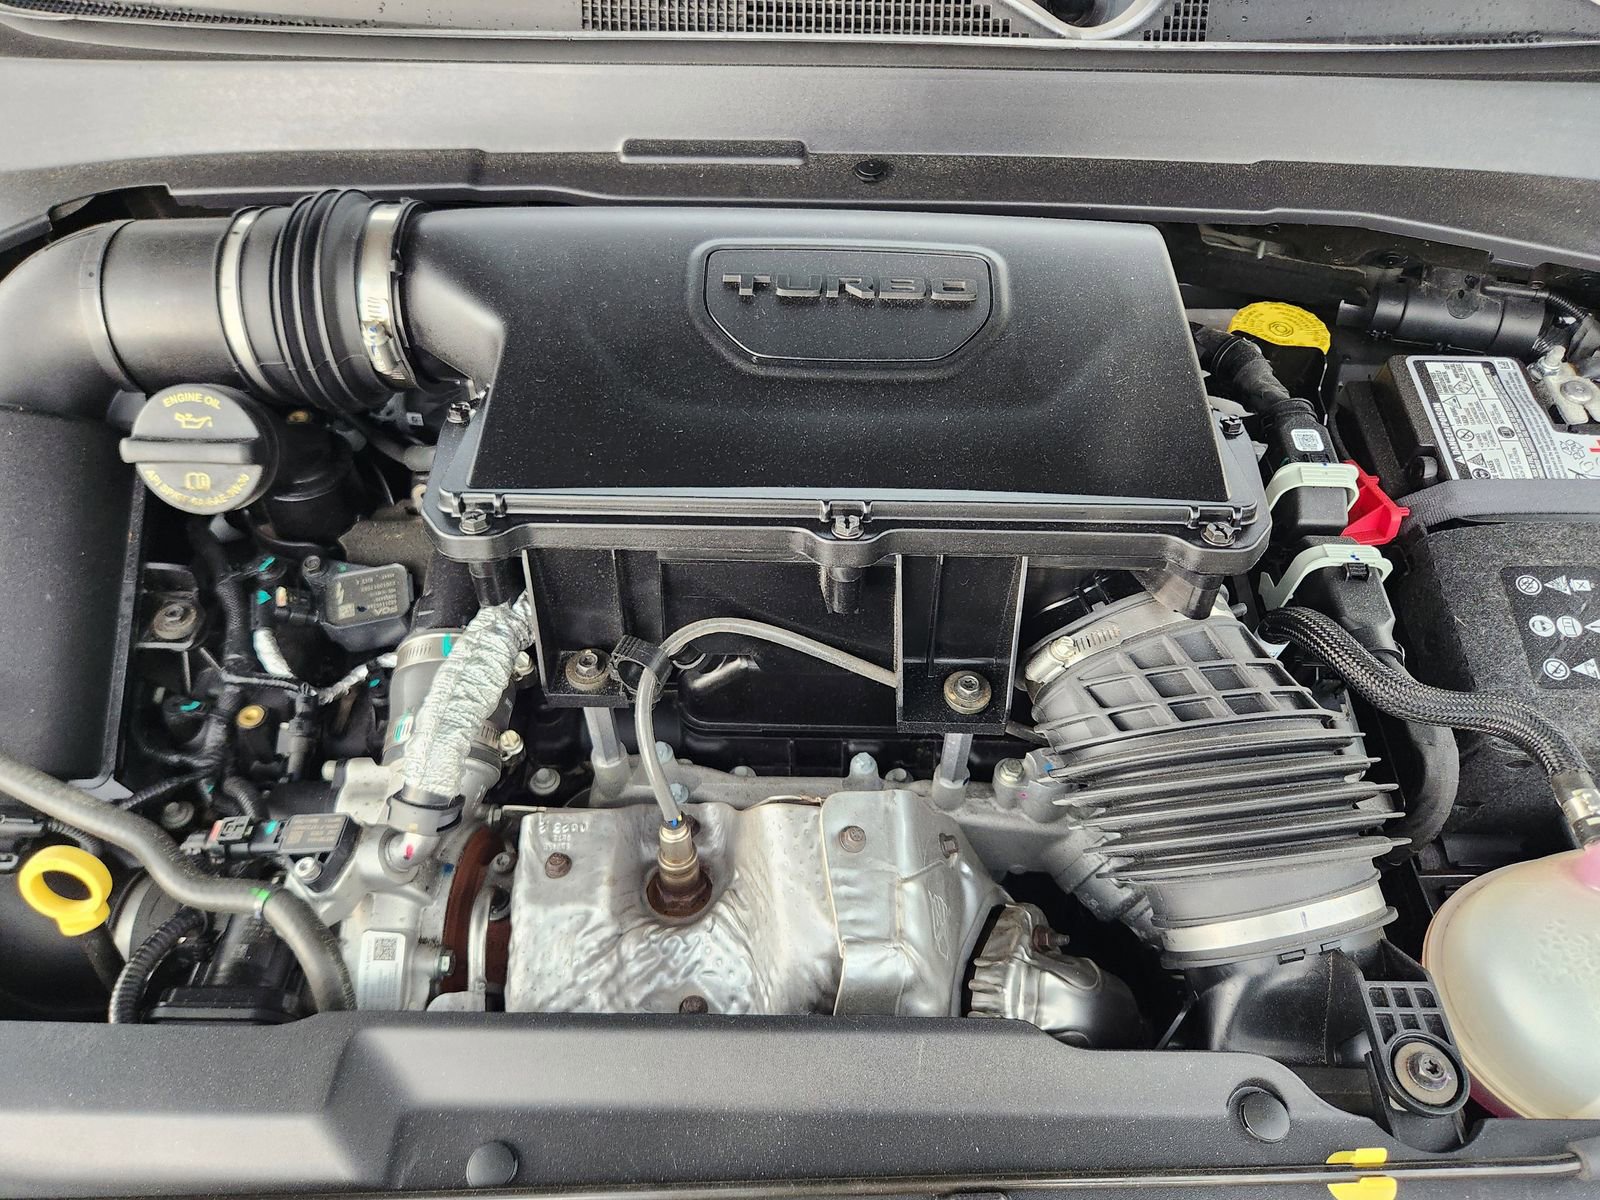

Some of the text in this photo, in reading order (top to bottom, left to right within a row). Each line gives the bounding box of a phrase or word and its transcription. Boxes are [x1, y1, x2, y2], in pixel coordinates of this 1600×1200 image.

[722, 272, 978, 303] TURBO
[163, 392, 221, 409] ENGINE OIL
